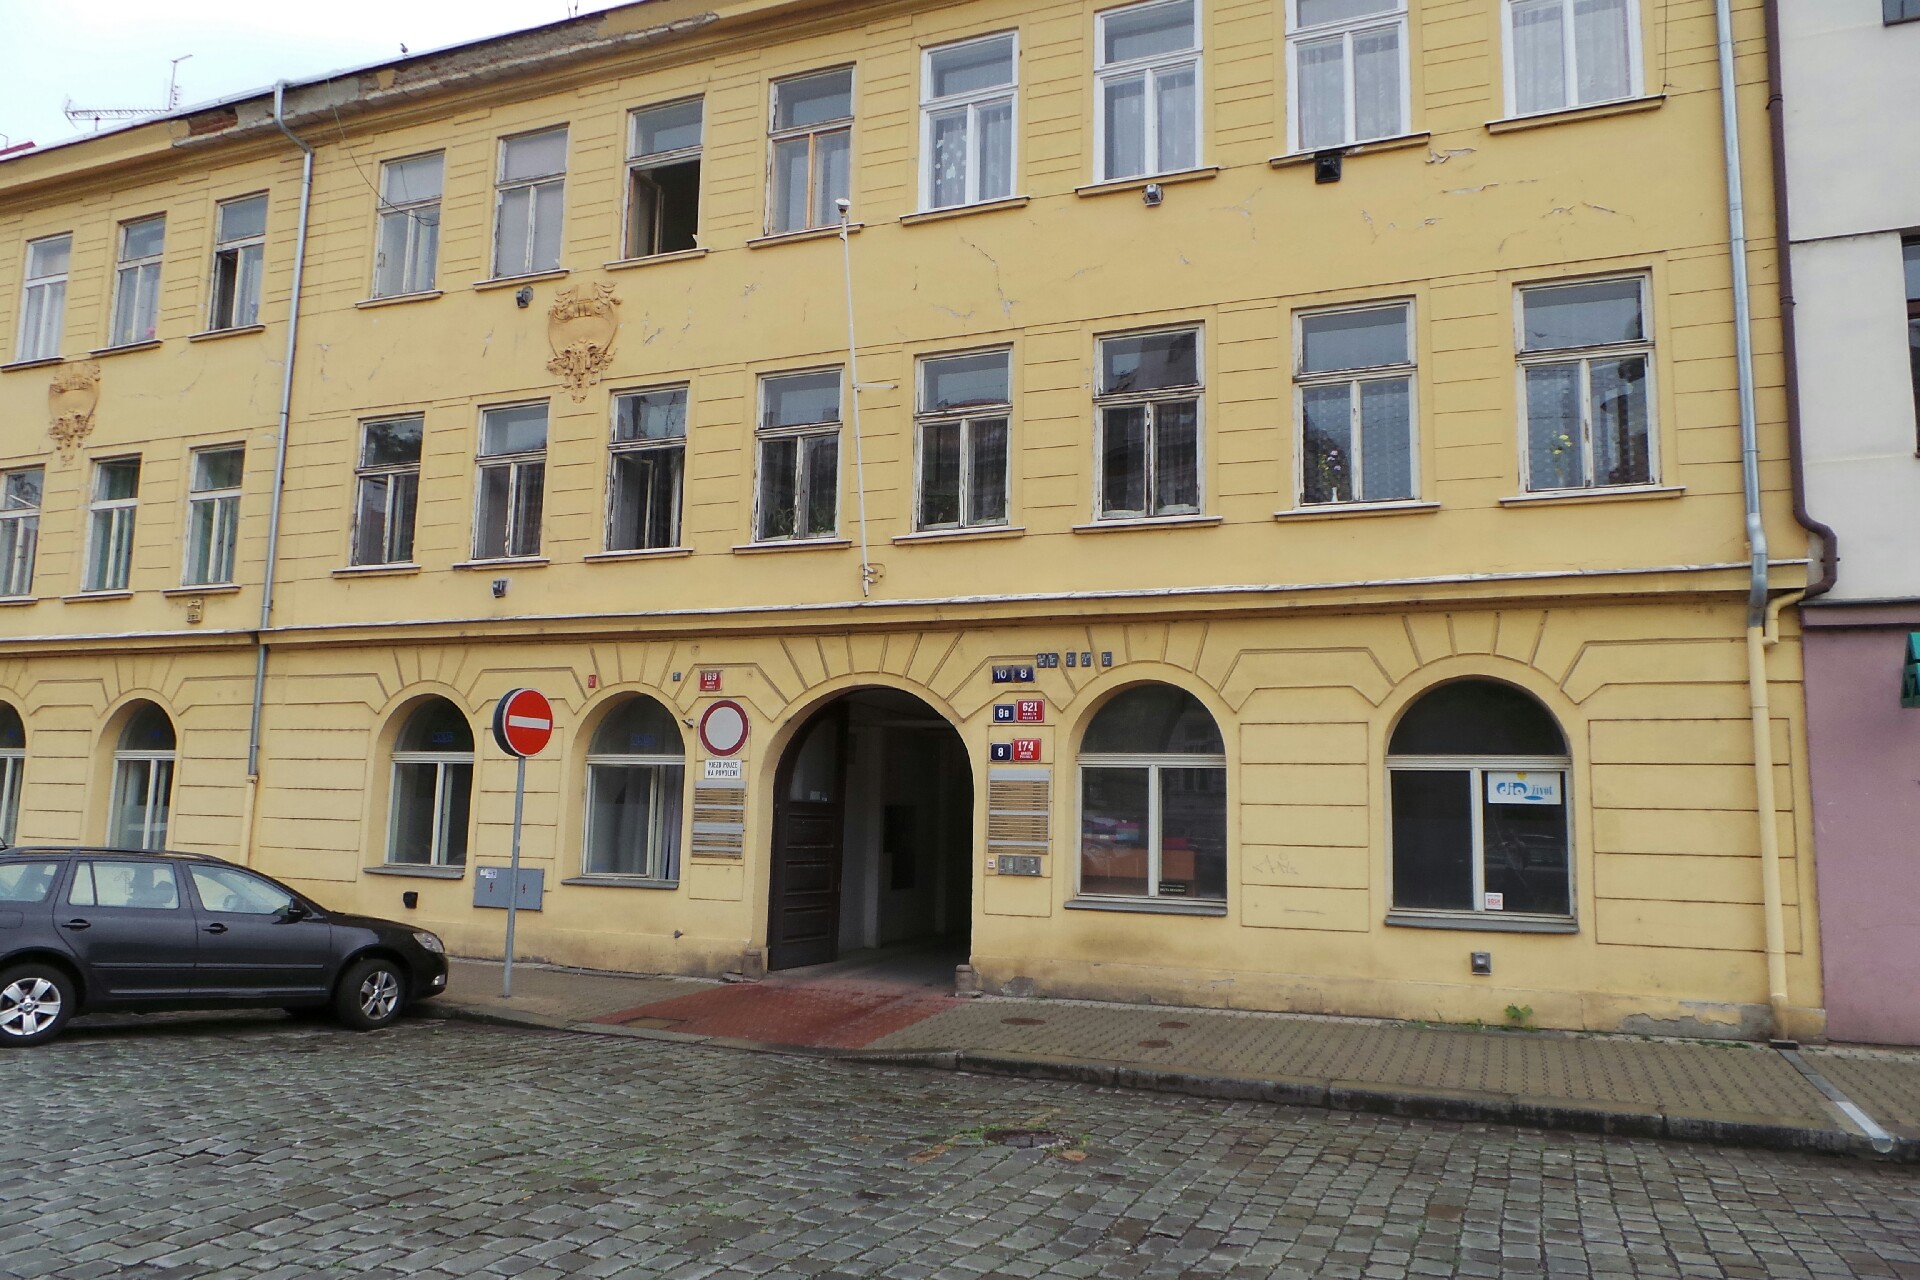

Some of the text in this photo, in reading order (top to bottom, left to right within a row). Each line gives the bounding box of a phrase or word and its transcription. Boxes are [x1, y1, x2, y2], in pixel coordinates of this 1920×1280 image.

[705, 672, 717, 681] 169
[996, 669, 1007, 680] 10
[1020, 668, 1027, 679] 8
[1022, 702, 1038, 712] 621
[1018, 741, 1034, 751] 174
[997, 747, 1004, 757] 8
[722, 761, 738, 769] POUZE
[707, 769, 714, 777] NA
